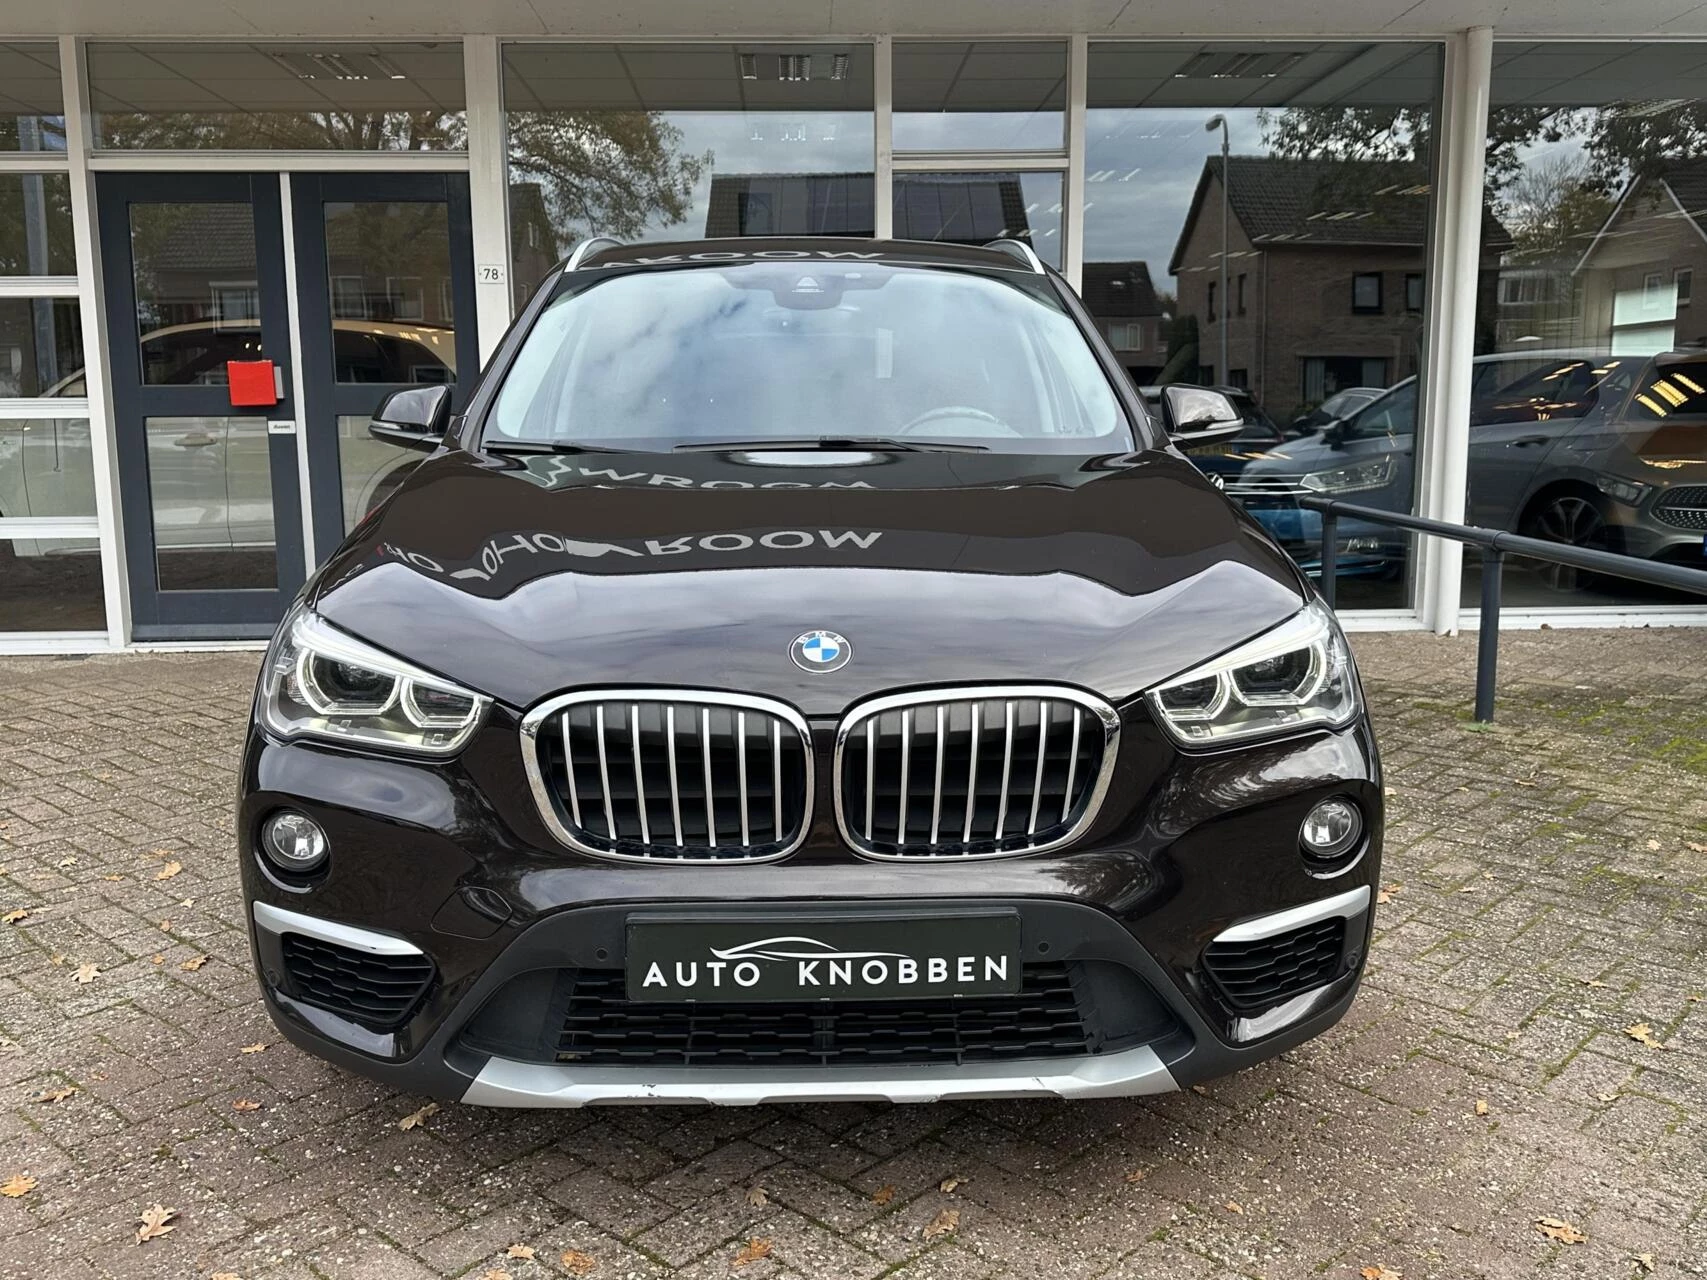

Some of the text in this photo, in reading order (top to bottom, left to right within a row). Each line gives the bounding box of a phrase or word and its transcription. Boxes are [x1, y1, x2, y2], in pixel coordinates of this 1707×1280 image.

[483, 268, 499, 281] 78
[642, 955, 1007, 987] AUTO KNOBBEN
